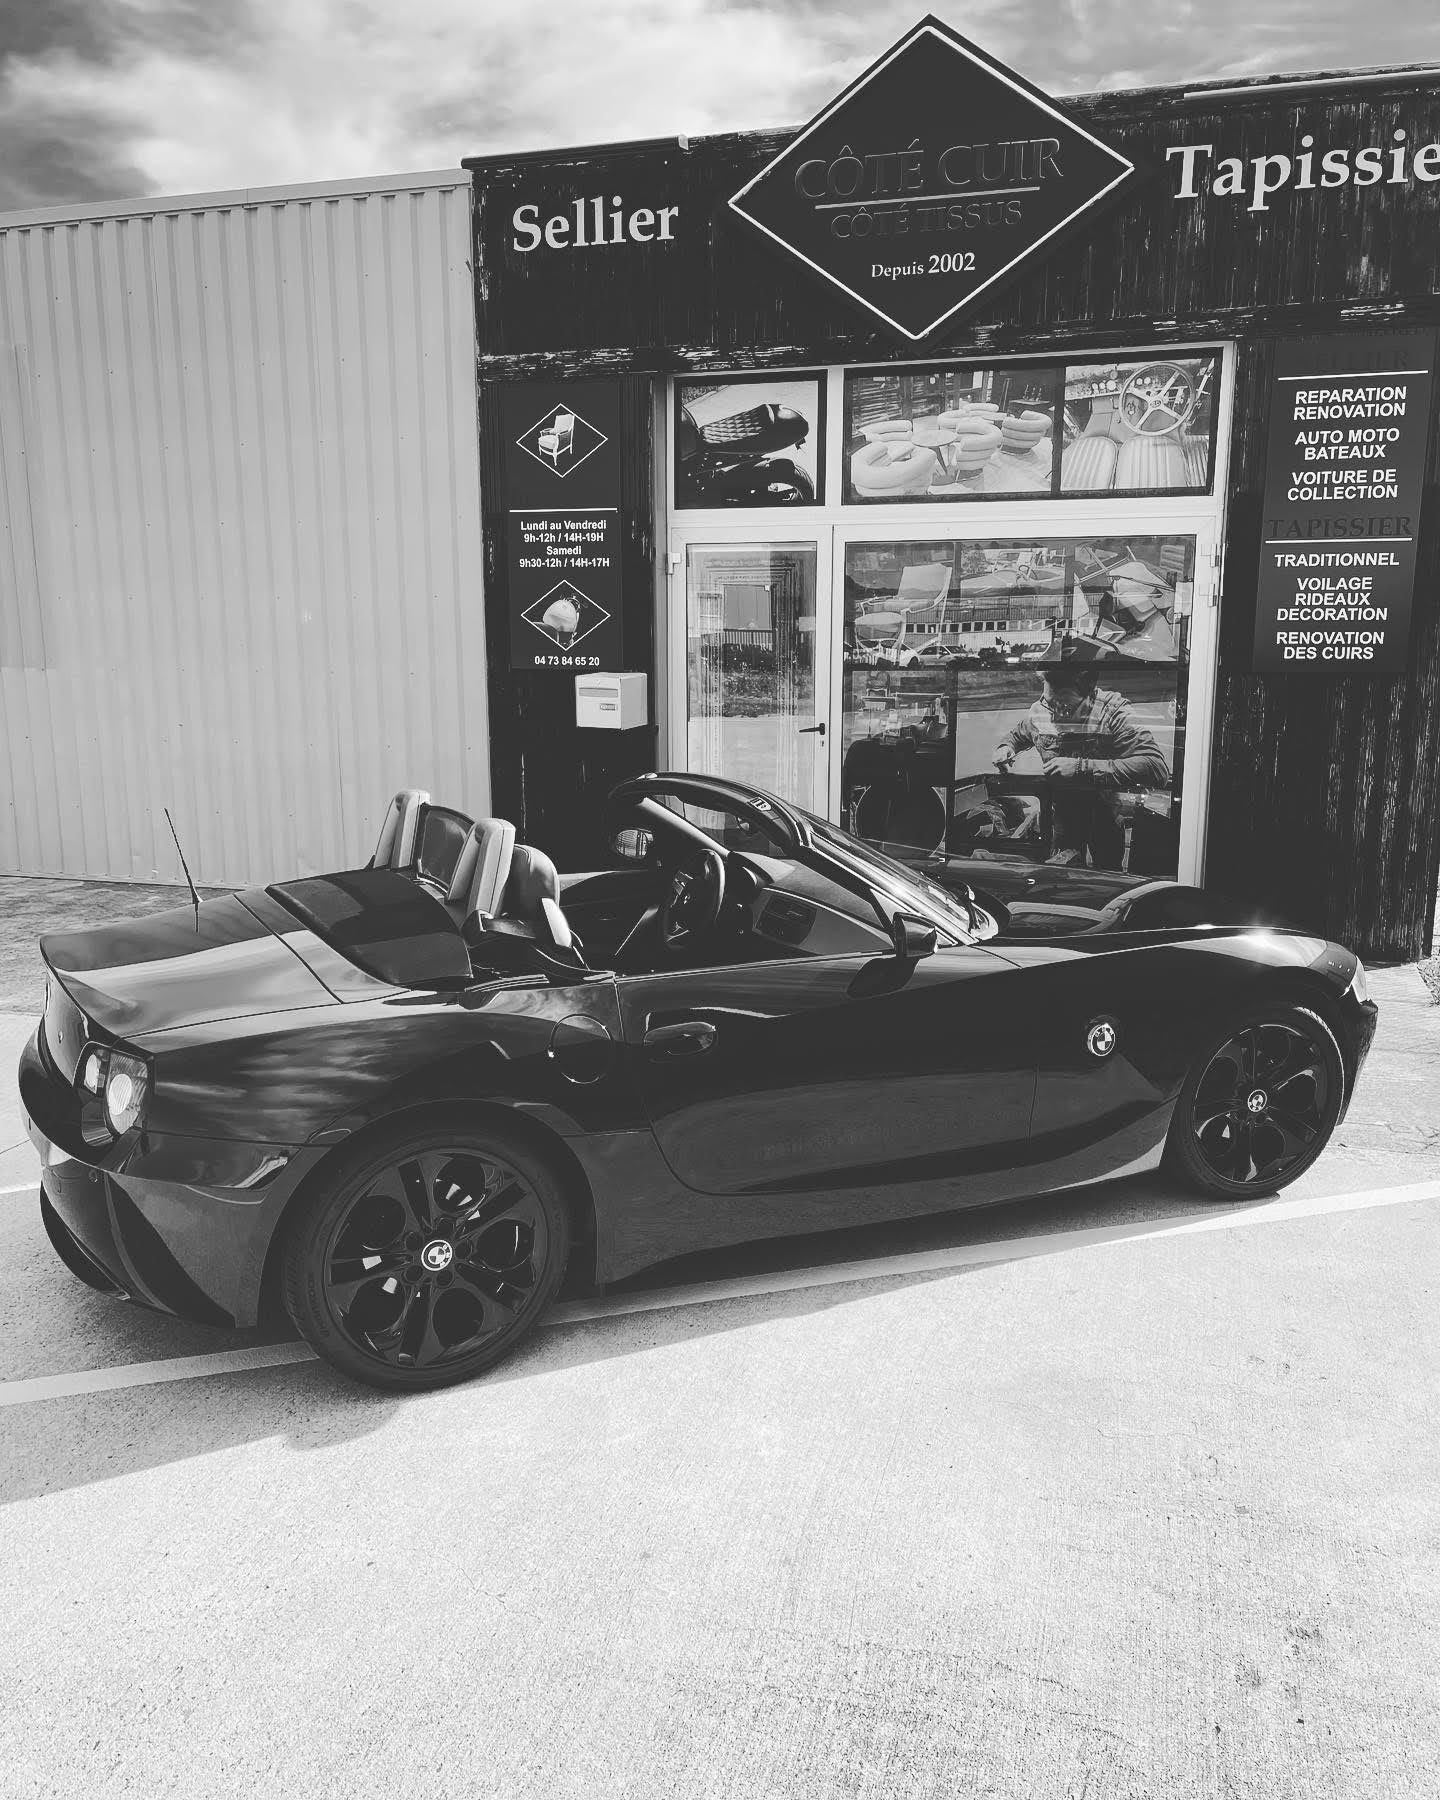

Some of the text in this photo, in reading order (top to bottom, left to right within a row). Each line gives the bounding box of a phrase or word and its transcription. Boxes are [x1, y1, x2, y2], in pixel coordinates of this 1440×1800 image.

[794, 137, 1065, 199] CÔTÉ CUIR
[512, 195, 679, 253] Sellier
[830, 199, 1023, 240] CÔTÉ TISSUS
[871, 252, 976, 281] Depuis 2002
[1295, 386, 1407, 405] REPARATION
[1293, 402, 1406, 421] RENOVATION
[1294, 427, 1400, 446] AUTO MOTO
[1304, 444, 1387, 461] BATEAUX
[1291, 469, 1397, 485] VOITURE DE
[1287, 485, 1399, 501] COLLECTION
[520, 519, 607, 531] Lundi au Vendredi
[1269, 516, 1413, 538] TAPISSIER
[523, 533, 556, 543] 9h-12h
[564, 532, 604, 542] 14H-19H
[546, 545, 582, 555] Samedi
[519, 558, 562, 568] 9h30-12h
[569, 557, 610, 567] 14H-17H
[1274, 552, 1400, 567] TRADITIONNEL
[1297, 577, 1373, 591] VOILAGE
[1294, 592, 1371, 606] RIDEAUX
[1276, 607, 1388, 621] DECORATION
[1276, 631, 1385, 645] RENOVATION
[534, 655, 600, 666] 04 73 84 65 20
[1283, 646, 1374, 660] DES CUIRS
